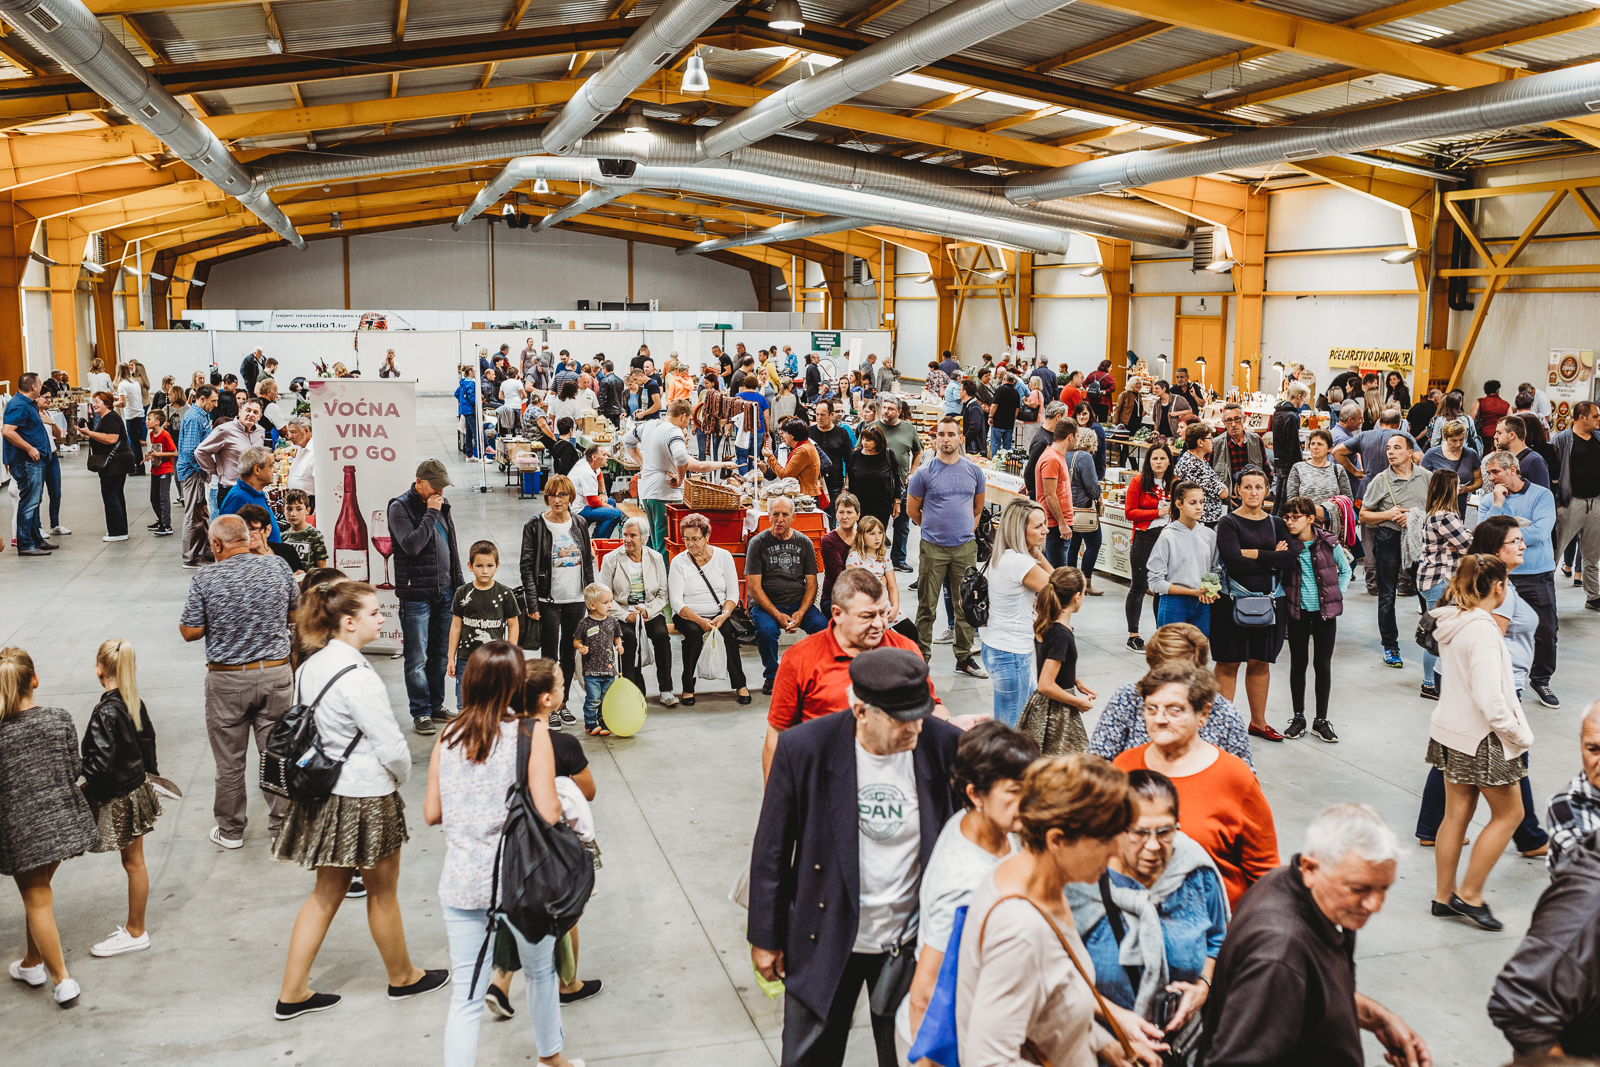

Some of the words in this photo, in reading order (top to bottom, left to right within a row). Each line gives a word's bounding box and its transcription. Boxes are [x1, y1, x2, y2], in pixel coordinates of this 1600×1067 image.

[275, 321, 348, 329] www.radio1.hr
[1329, 347, 1375, 361] PČELARSTVO
[323, 397, 401, 418] VOĆNA
[335, 423, 389, 440] VINA
[328, 445, 358, 461] TO
[365, 445, 397, 462] GO
[767, 544, 780, 554] TOM
[781, 543, 802, 554] TAILOR
[858, 803, 903, 819] PAN
